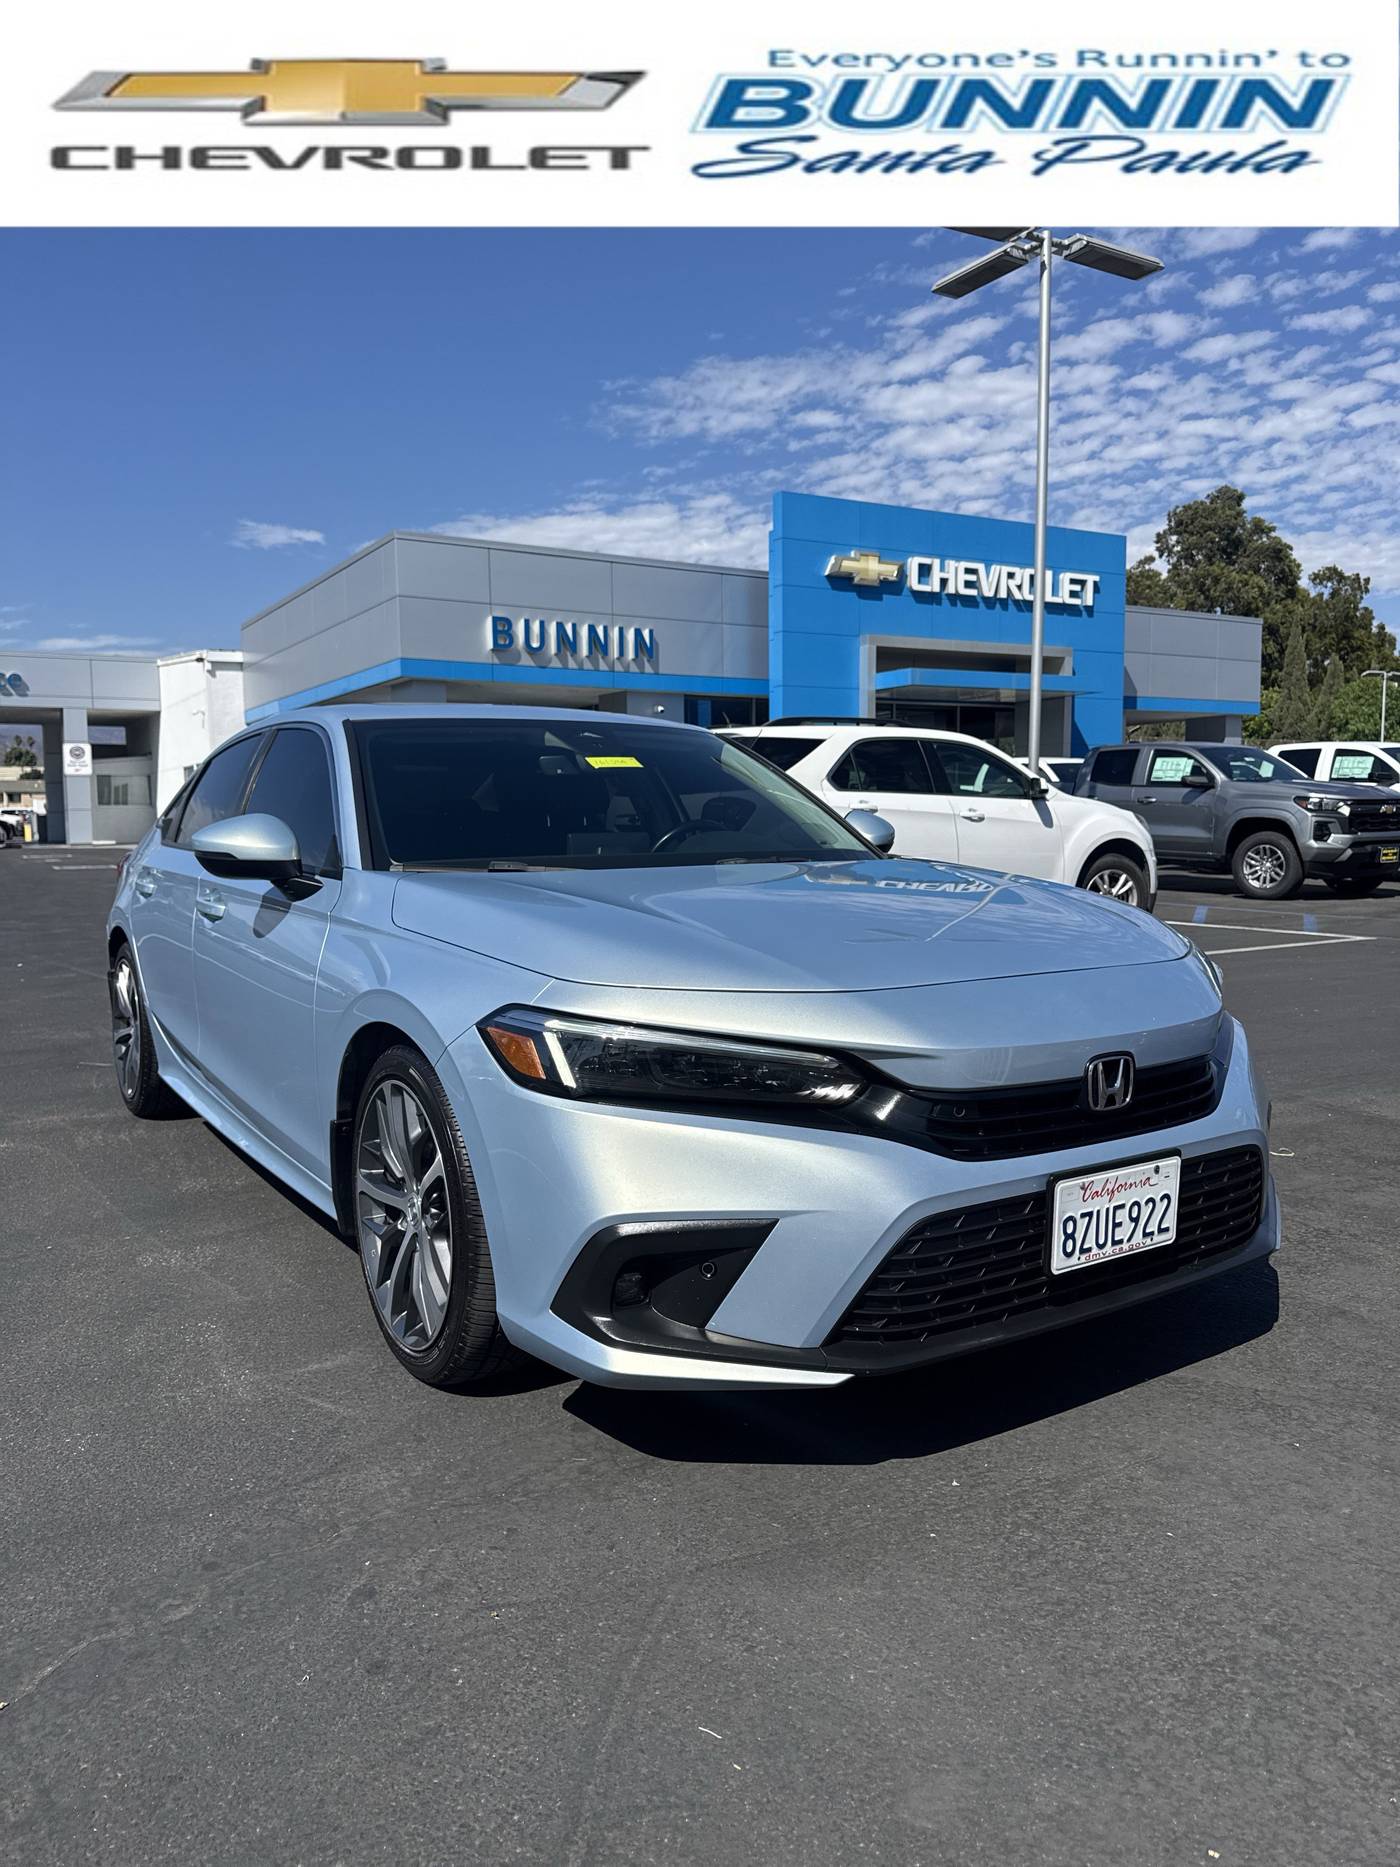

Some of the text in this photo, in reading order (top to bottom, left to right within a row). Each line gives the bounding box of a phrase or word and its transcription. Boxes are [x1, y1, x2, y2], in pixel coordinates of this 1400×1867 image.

[907, 556, 1100, 606] CHEVROLET
[488, 615, 655, 660] BUNNIN
[1082, 1175, 1159, 1203] California
[1061, 1192, 1172, 1259] 8ZUE922
[1084, 1239, 1148, 1262] dmv.ca.gov
